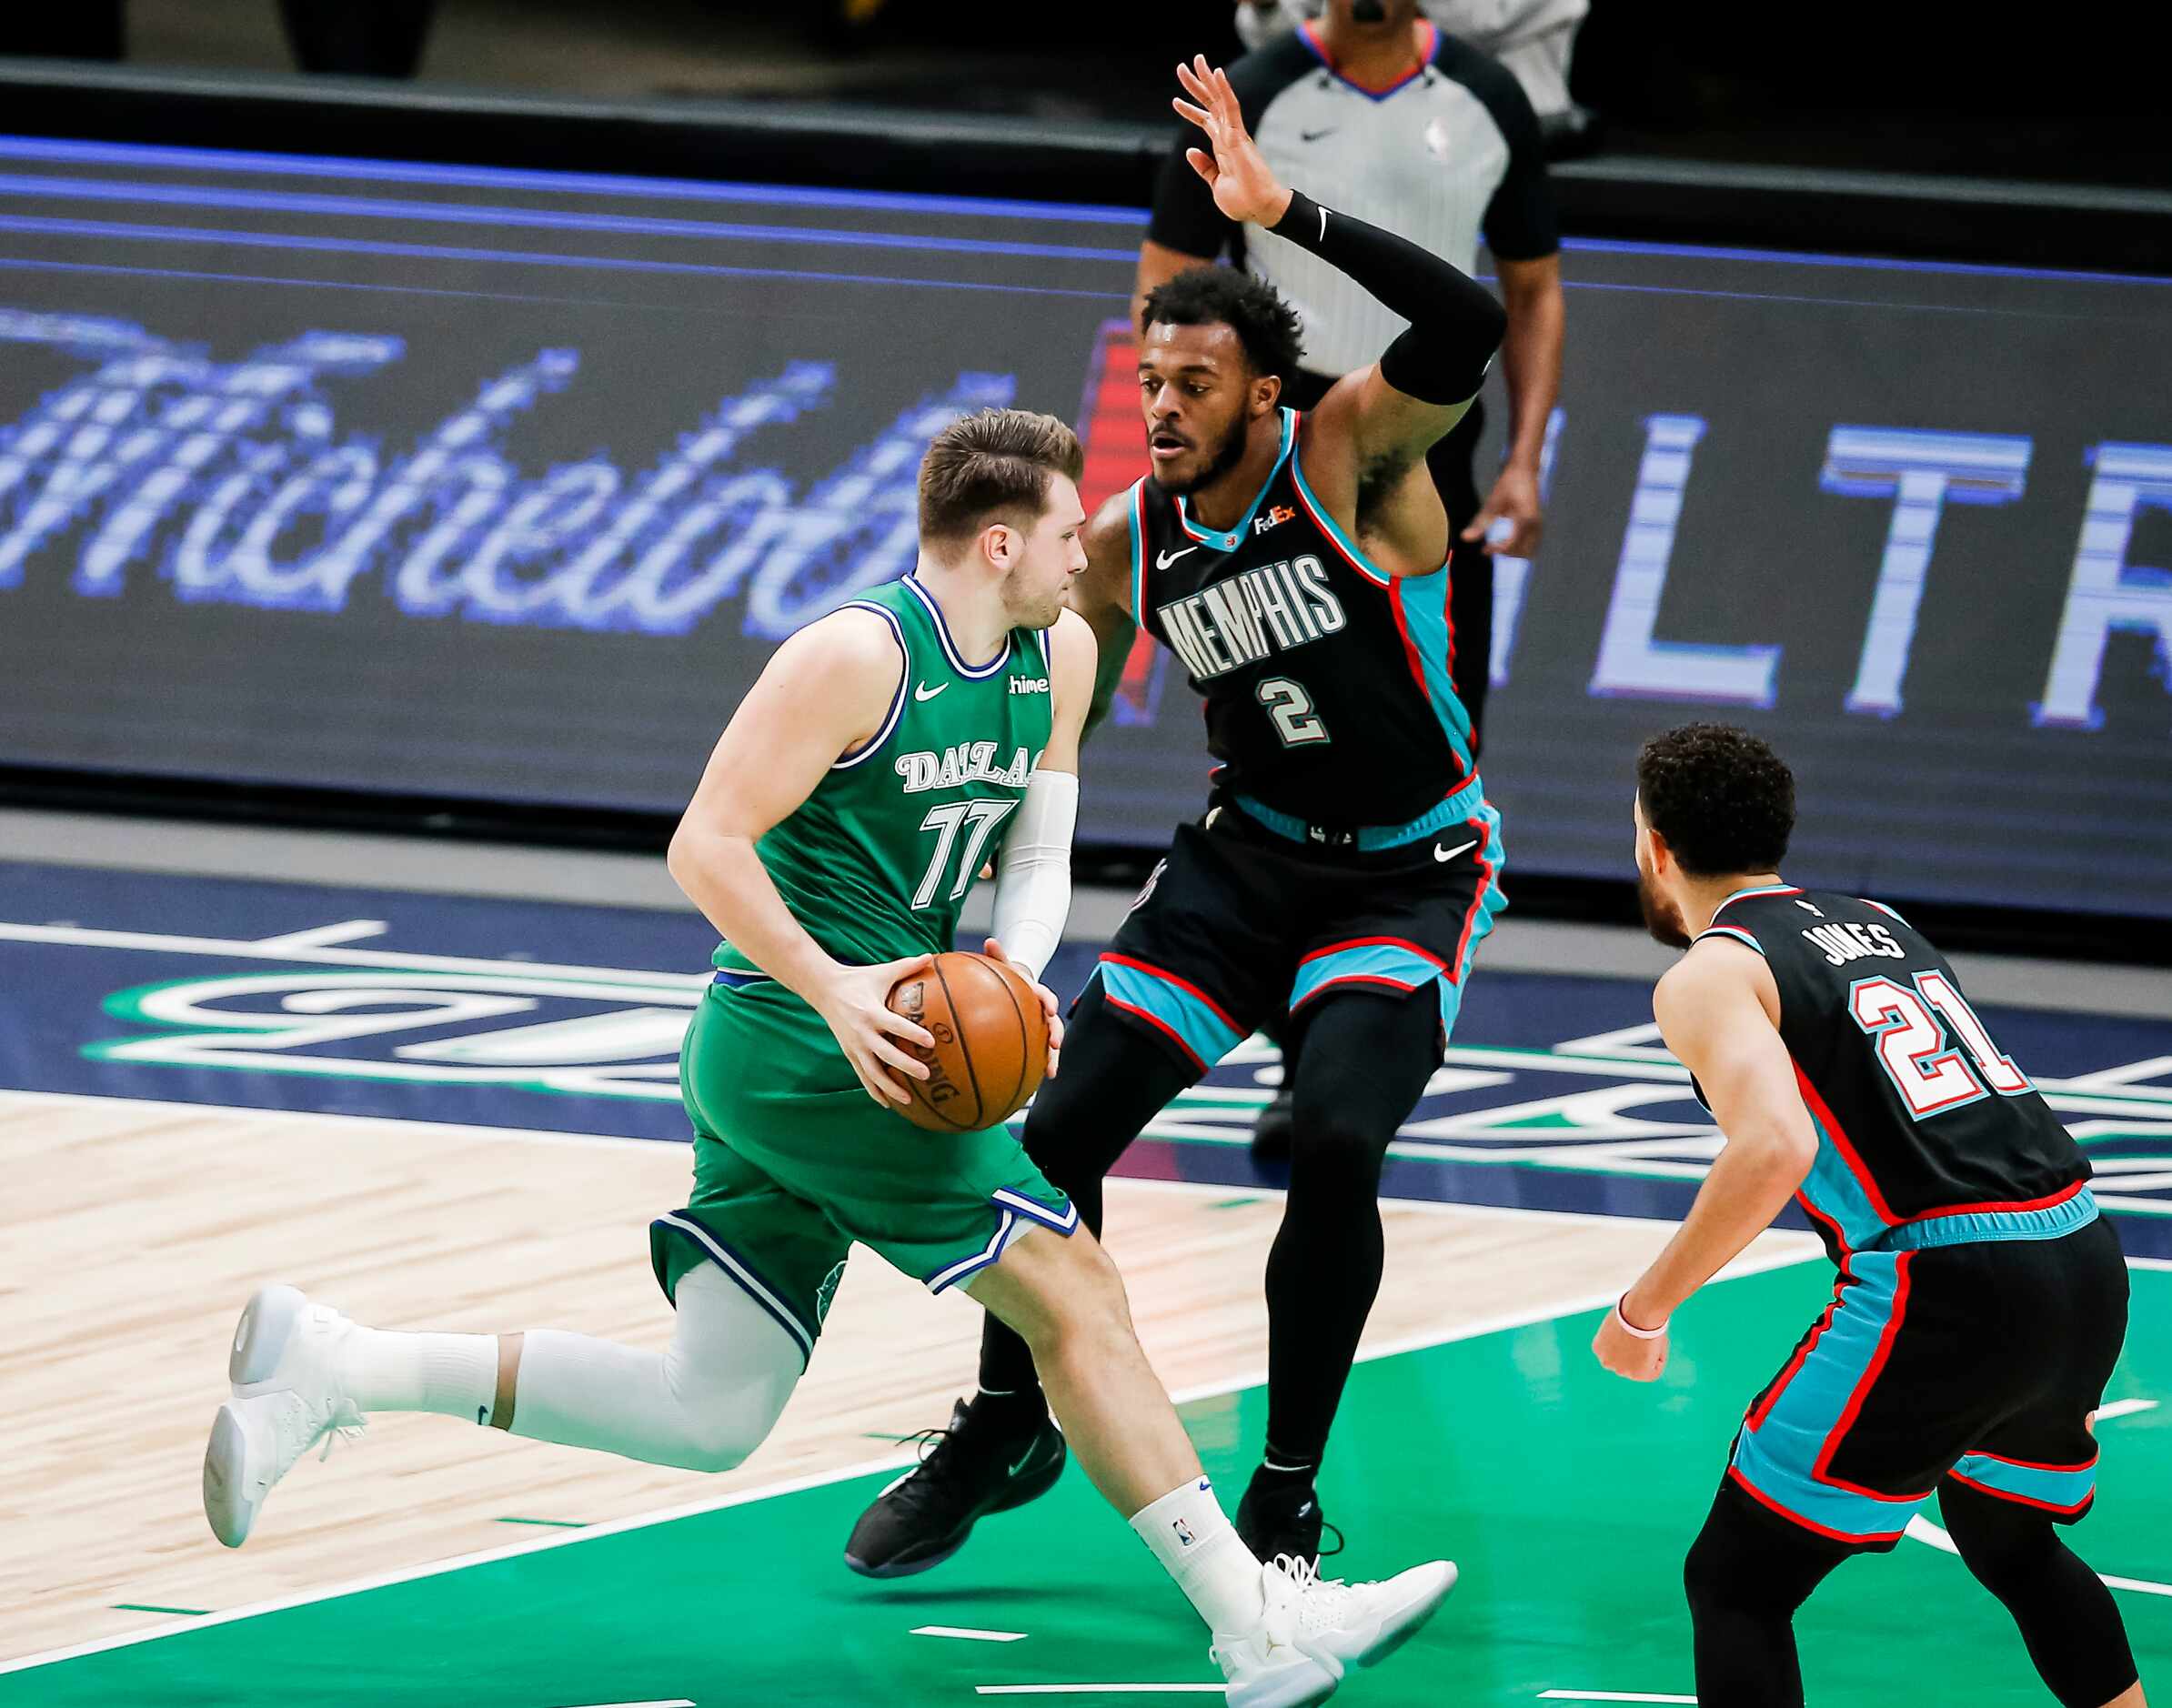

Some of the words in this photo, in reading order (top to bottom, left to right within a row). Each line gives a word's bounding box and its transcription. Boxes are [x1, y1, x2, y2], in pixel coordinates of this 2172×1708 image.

[1253, 505, 1296, 536] FedEx
[1489, 407, 2172, 731] LTR
[1157, 554, 1346, 681] MEMPHIS
[1008, 674, 1050, 695] hime
[1256, 676, 1332, 749] 2
[910, 798, 1021, 910] 77
[1802, 922, 1906, 968] JONES
[1848, 969, 2037, 1122] 21
